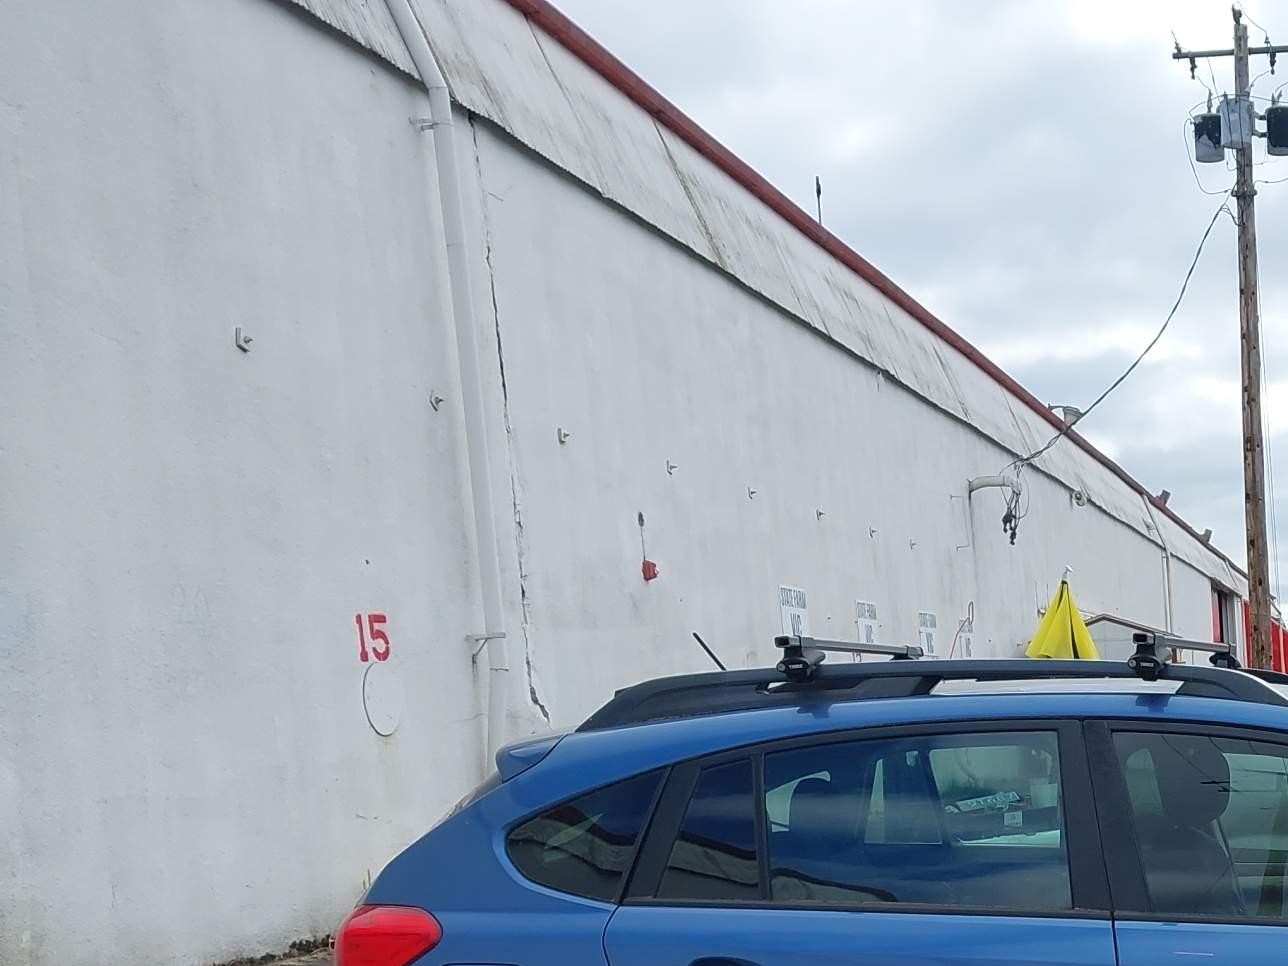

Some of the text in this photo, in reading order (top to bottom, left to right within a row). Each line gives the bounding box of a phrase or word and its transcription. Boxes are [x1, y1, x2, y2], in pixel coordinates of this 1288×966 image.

[780, 587, 807, 610] STATE FARM
[354, 612, 391, 662] 15
